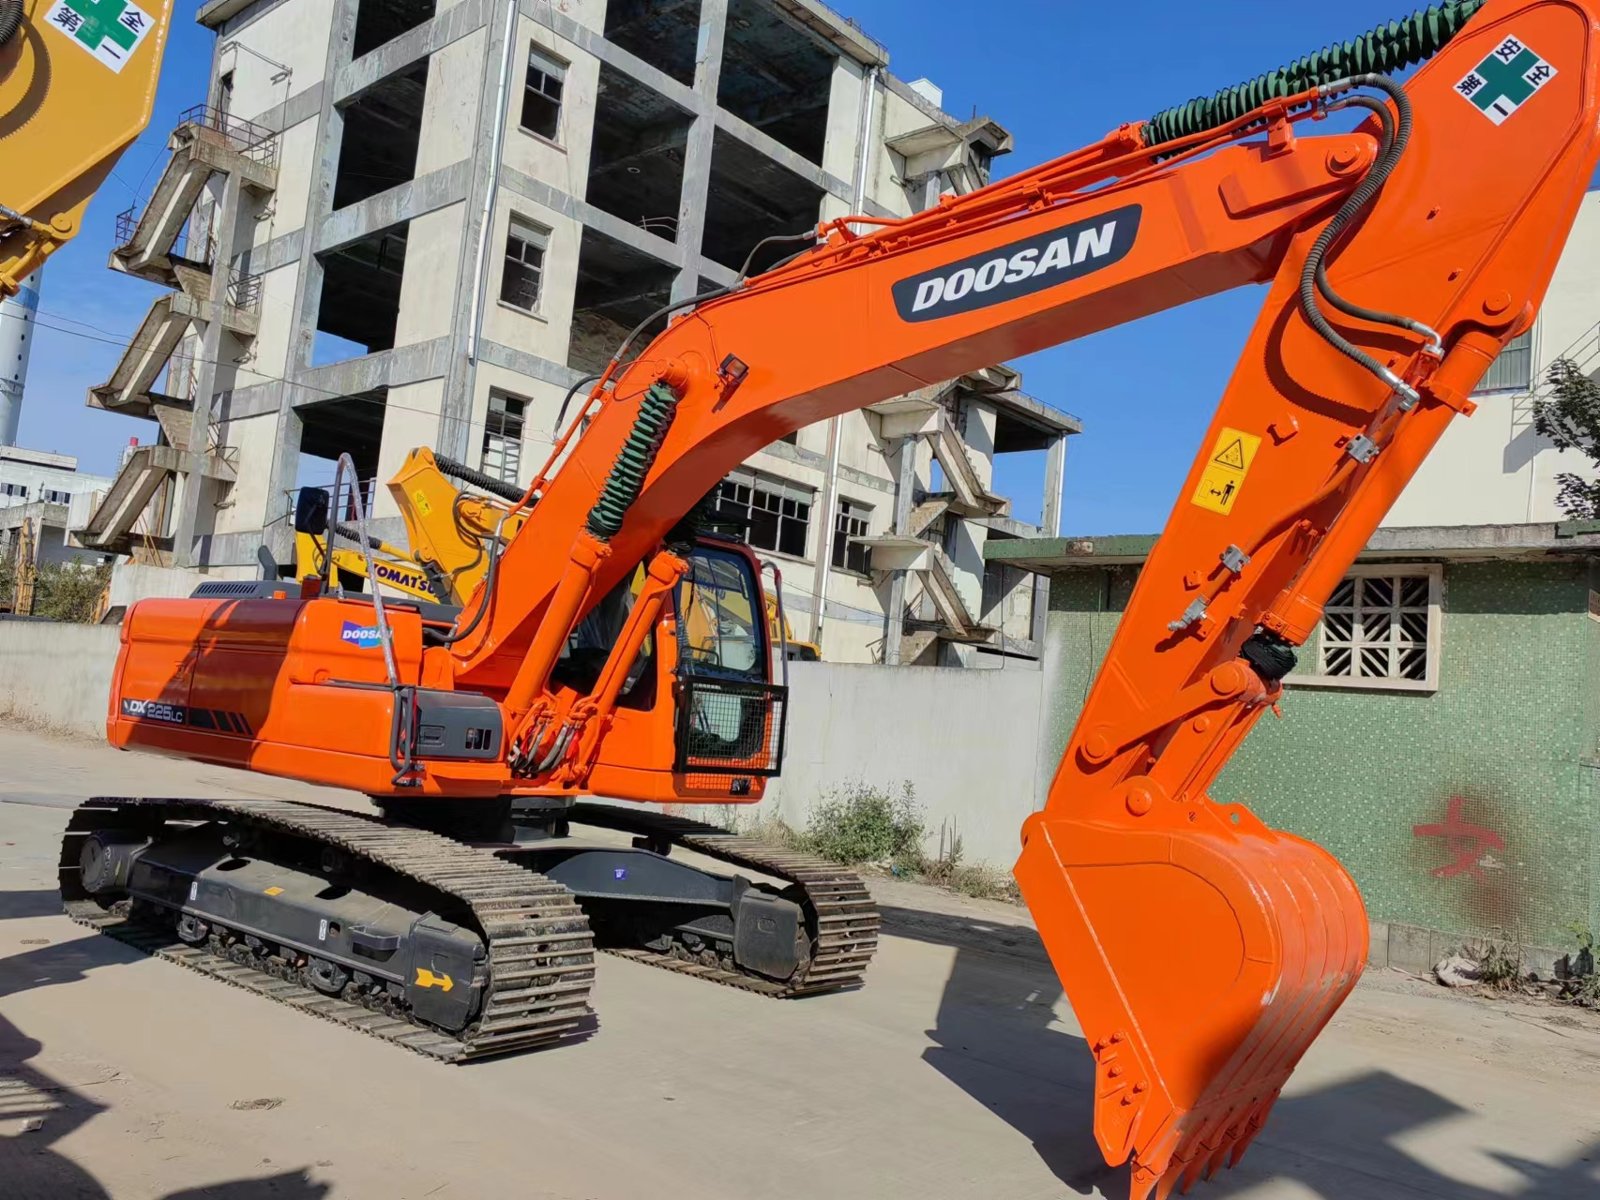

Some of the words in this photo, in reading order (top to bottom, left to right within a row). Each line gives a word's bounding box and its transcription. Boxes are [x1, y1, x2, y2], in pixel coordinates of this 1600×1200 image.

[911, 220, 1117, 313] DOOSAN
[366, 562, 436, 594] OMATSU
[342, 630, 393, 640] DOOSA
